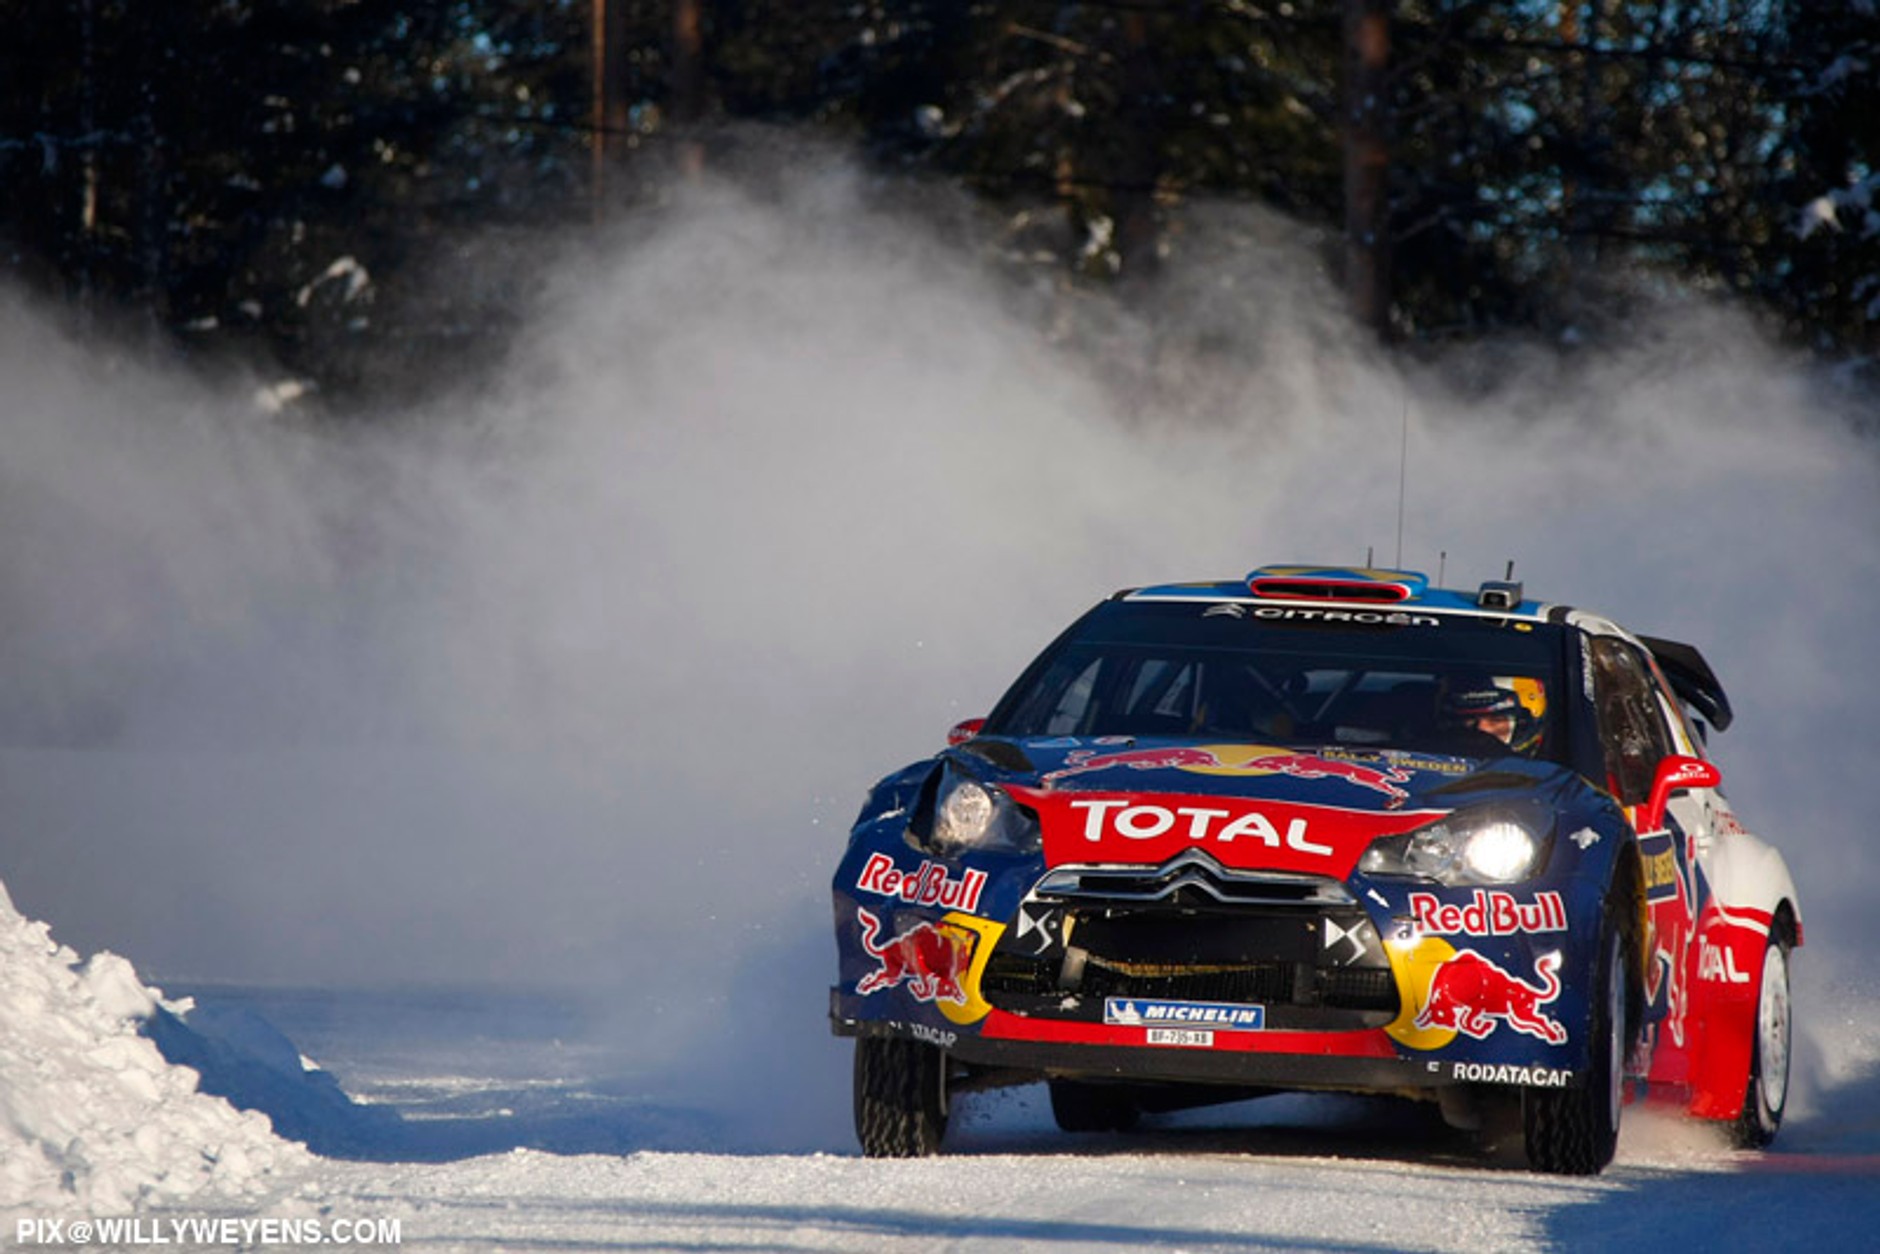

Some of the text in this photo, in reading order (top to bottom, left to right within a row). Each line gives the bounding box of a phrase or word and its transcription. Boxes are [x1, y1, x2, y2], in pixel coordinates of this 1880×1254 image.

[1388, 757, 1467, 773] SWEDEN
[1070, 800, 1334, 857] TOTAL
[858, 853, 988, 914] Red Bull
[1409, 889, 1568, 936] Red Bull
[1144, 1005, 1257, 1024] MICHELIN
